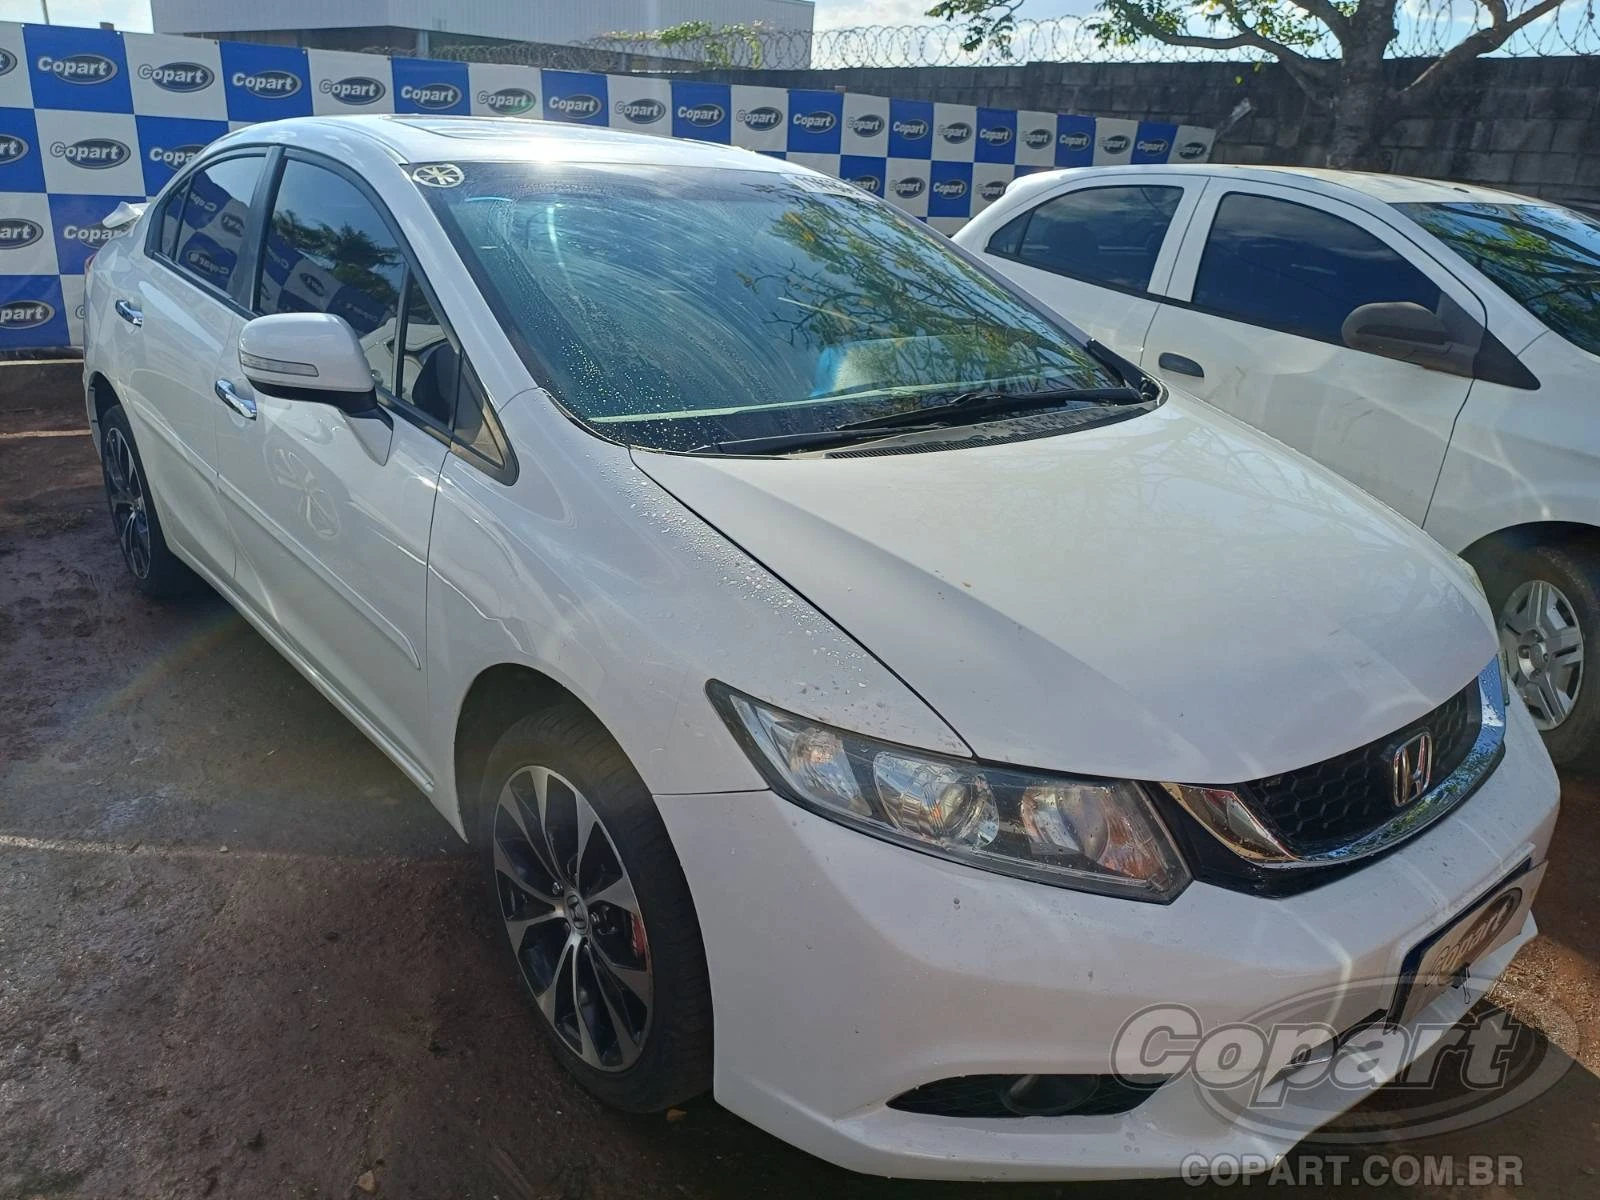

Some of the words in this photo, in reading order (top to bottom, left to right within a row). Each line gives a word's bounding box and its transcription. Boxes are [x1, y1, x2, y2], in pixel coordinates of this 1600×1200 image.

[37, 56, 107, 77] Copart
[138, 64, 203, 86] Copart
[232, 72, 293, 91] Copart
[319, 79, 377, 98] Copart
[401, 85, 453, 103] Copart
[477, 91, 528, 108] Copart
[549, 96, 594, 112] Copart
[615, 102, 659, 118] Copart
[678, 107, 720, 122] Copart
[736, 110, 777, 125] Copart
[793, 112, 832, 127] Copart
[848, 116, 880, 131] Copart
[893, 120, 924, 135] Copart
[938, 124, 968, 139] Copart
[980, 128, 1010, 141] Copart
[50, 141, 118, 163] Copart
[150, 147, 198, 166] Copa
[889, 179, 921, 194] Copart
[933, 182, 964, 196] Copart
[0, 224, 31, 239] art
[0, 306, 44, 322] part
